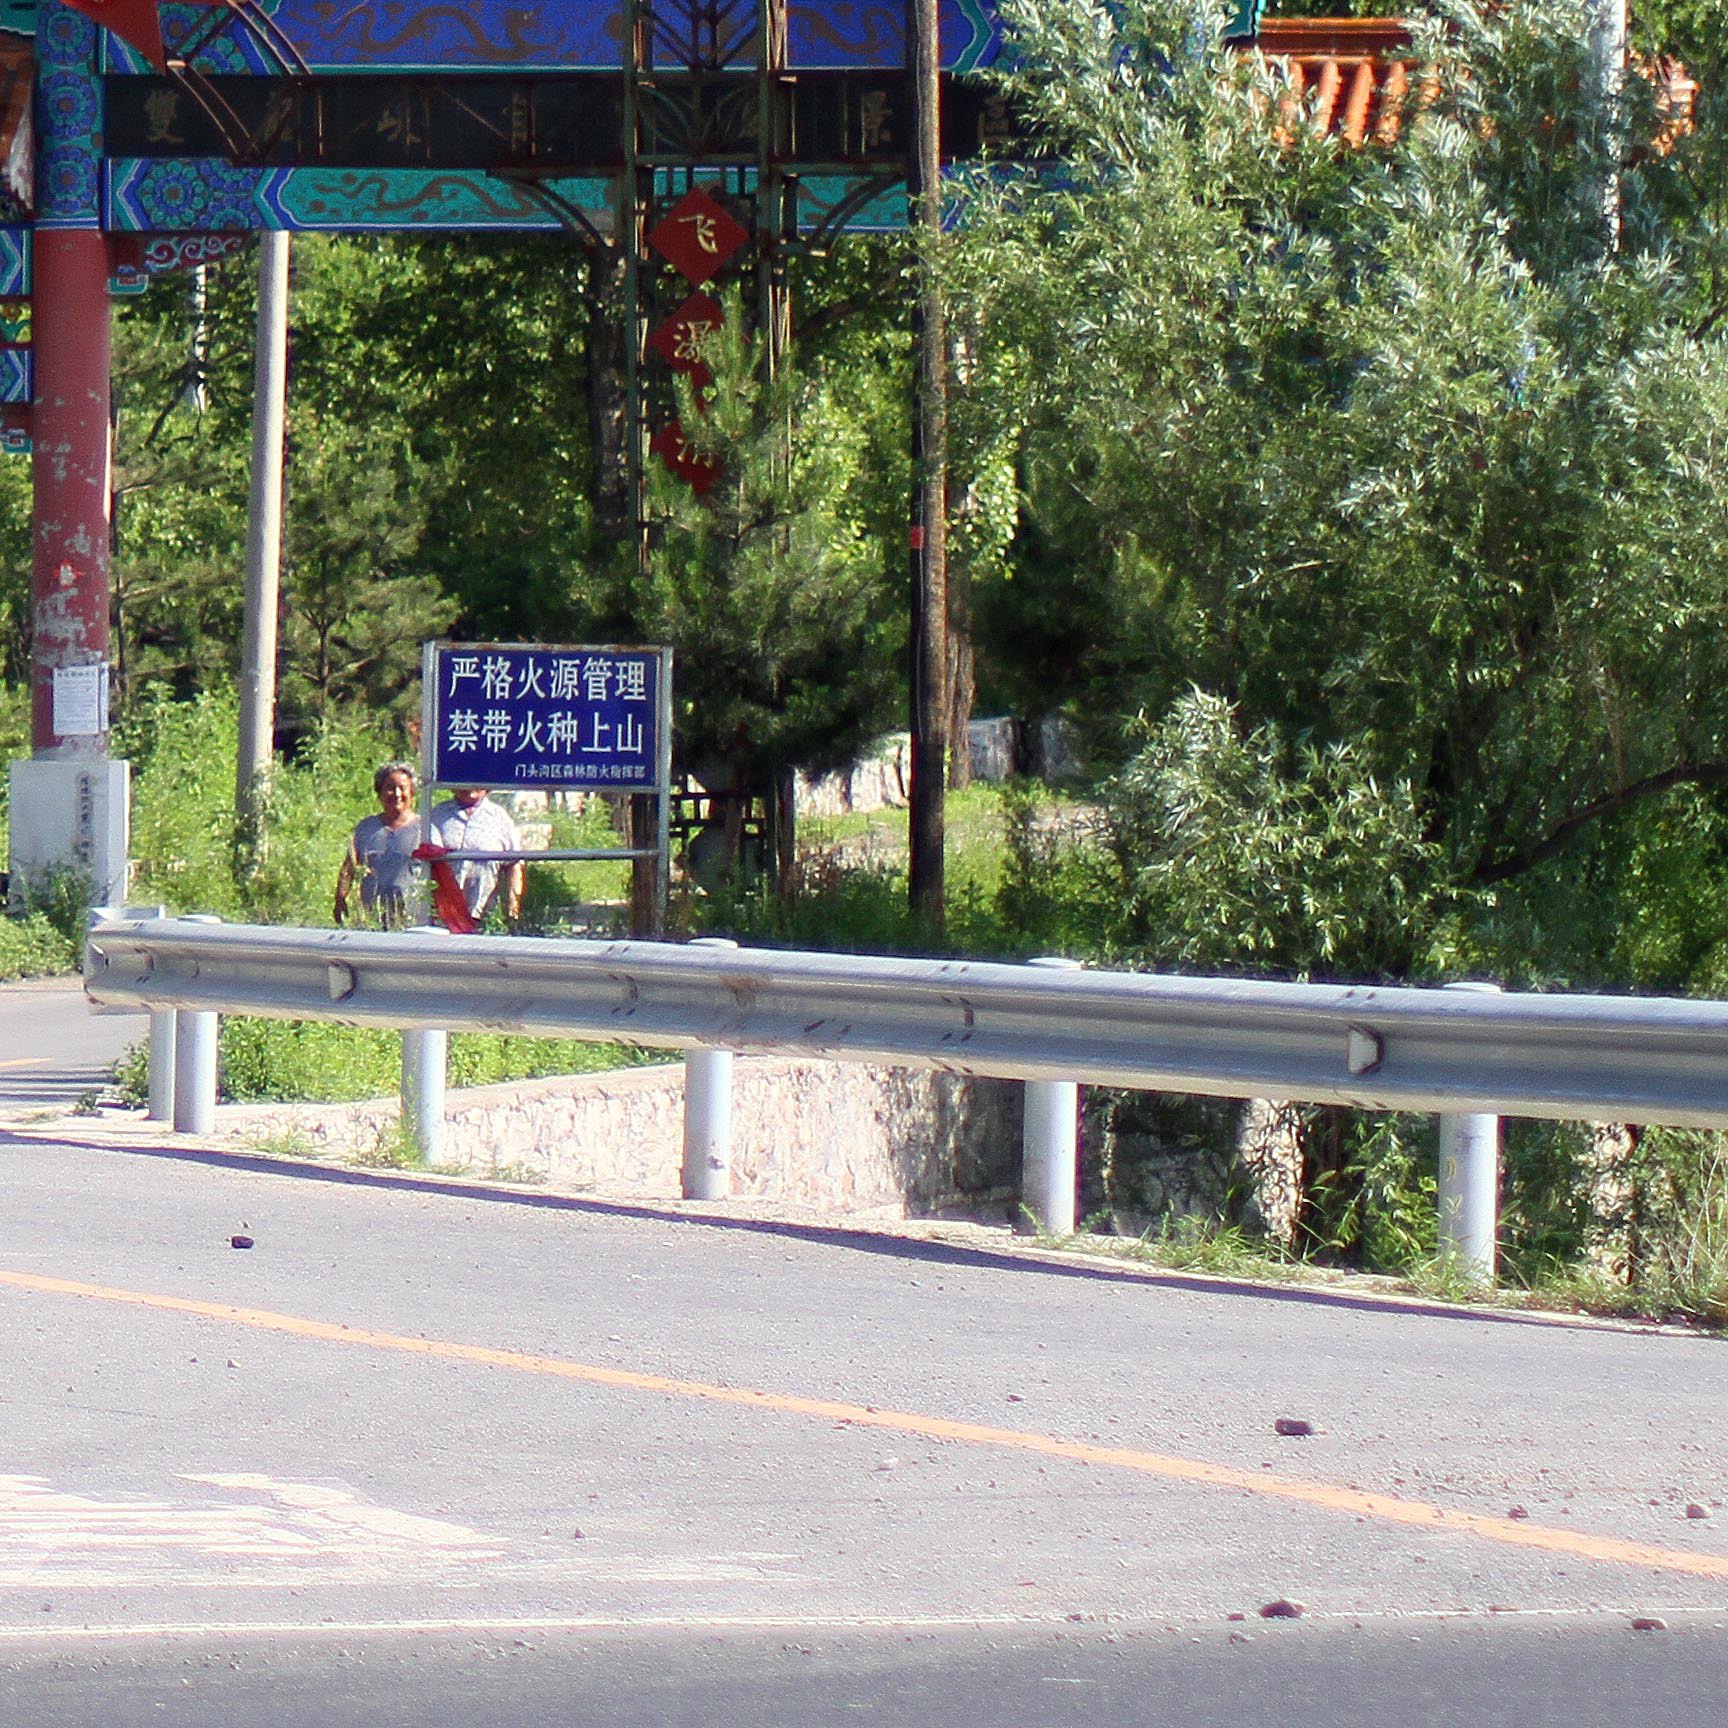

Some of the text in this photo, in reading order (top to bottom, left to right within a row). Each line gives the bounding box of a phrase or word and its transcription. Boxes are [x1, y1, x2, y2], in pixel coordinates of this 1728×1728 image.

[448, 655, 647, 702] 严格火源管理
[447, 708, 644, 755] 禁带火种上山
